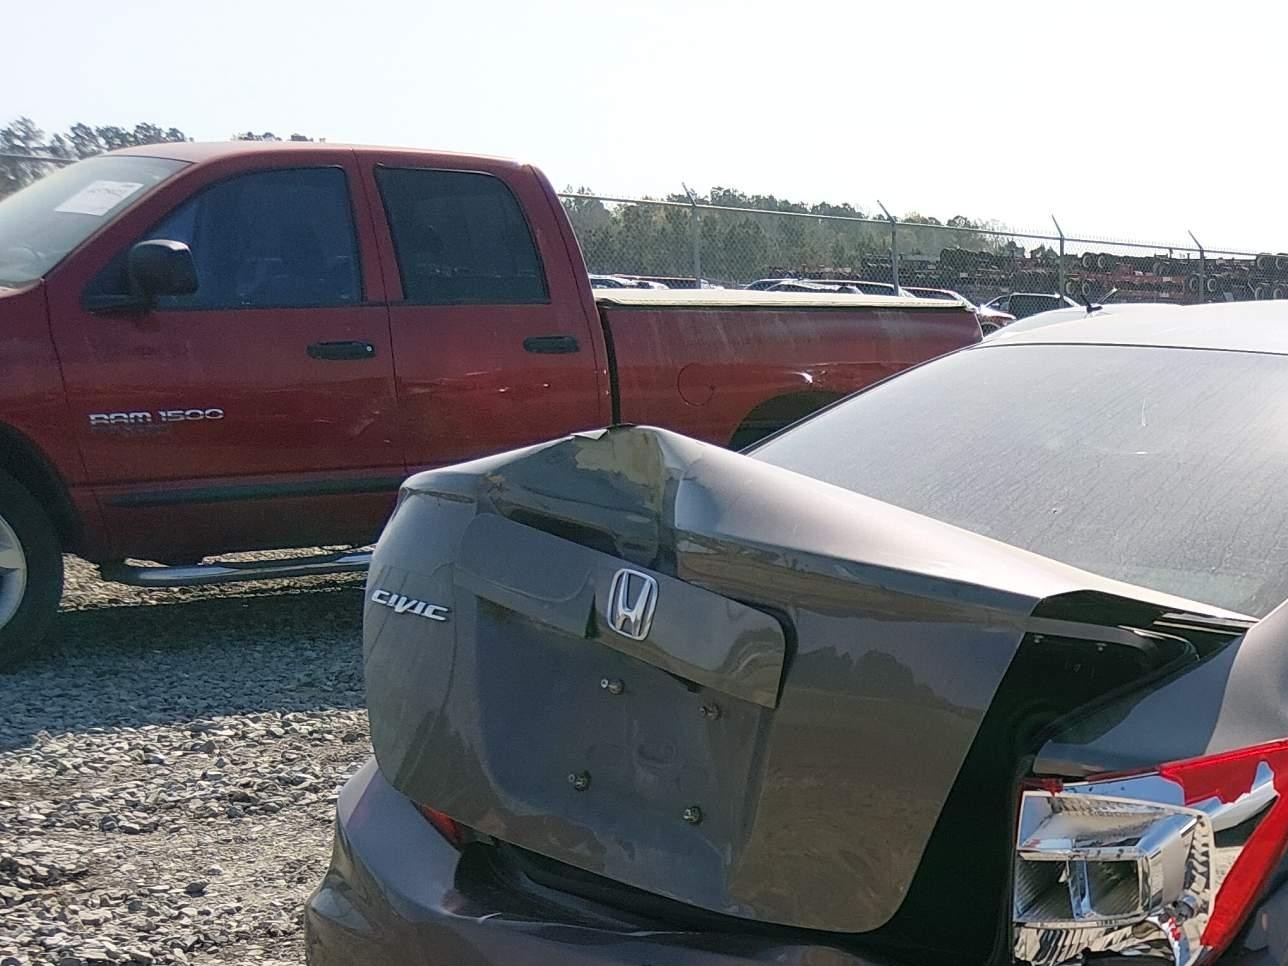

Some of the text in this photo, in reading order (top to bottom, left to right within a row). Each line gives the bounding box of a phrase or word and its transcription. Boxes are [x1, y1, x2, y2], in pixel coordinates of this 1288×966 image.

[89, 408, 225, 425] RAM 1500
[371, 589, 449, 621] CIVIC
